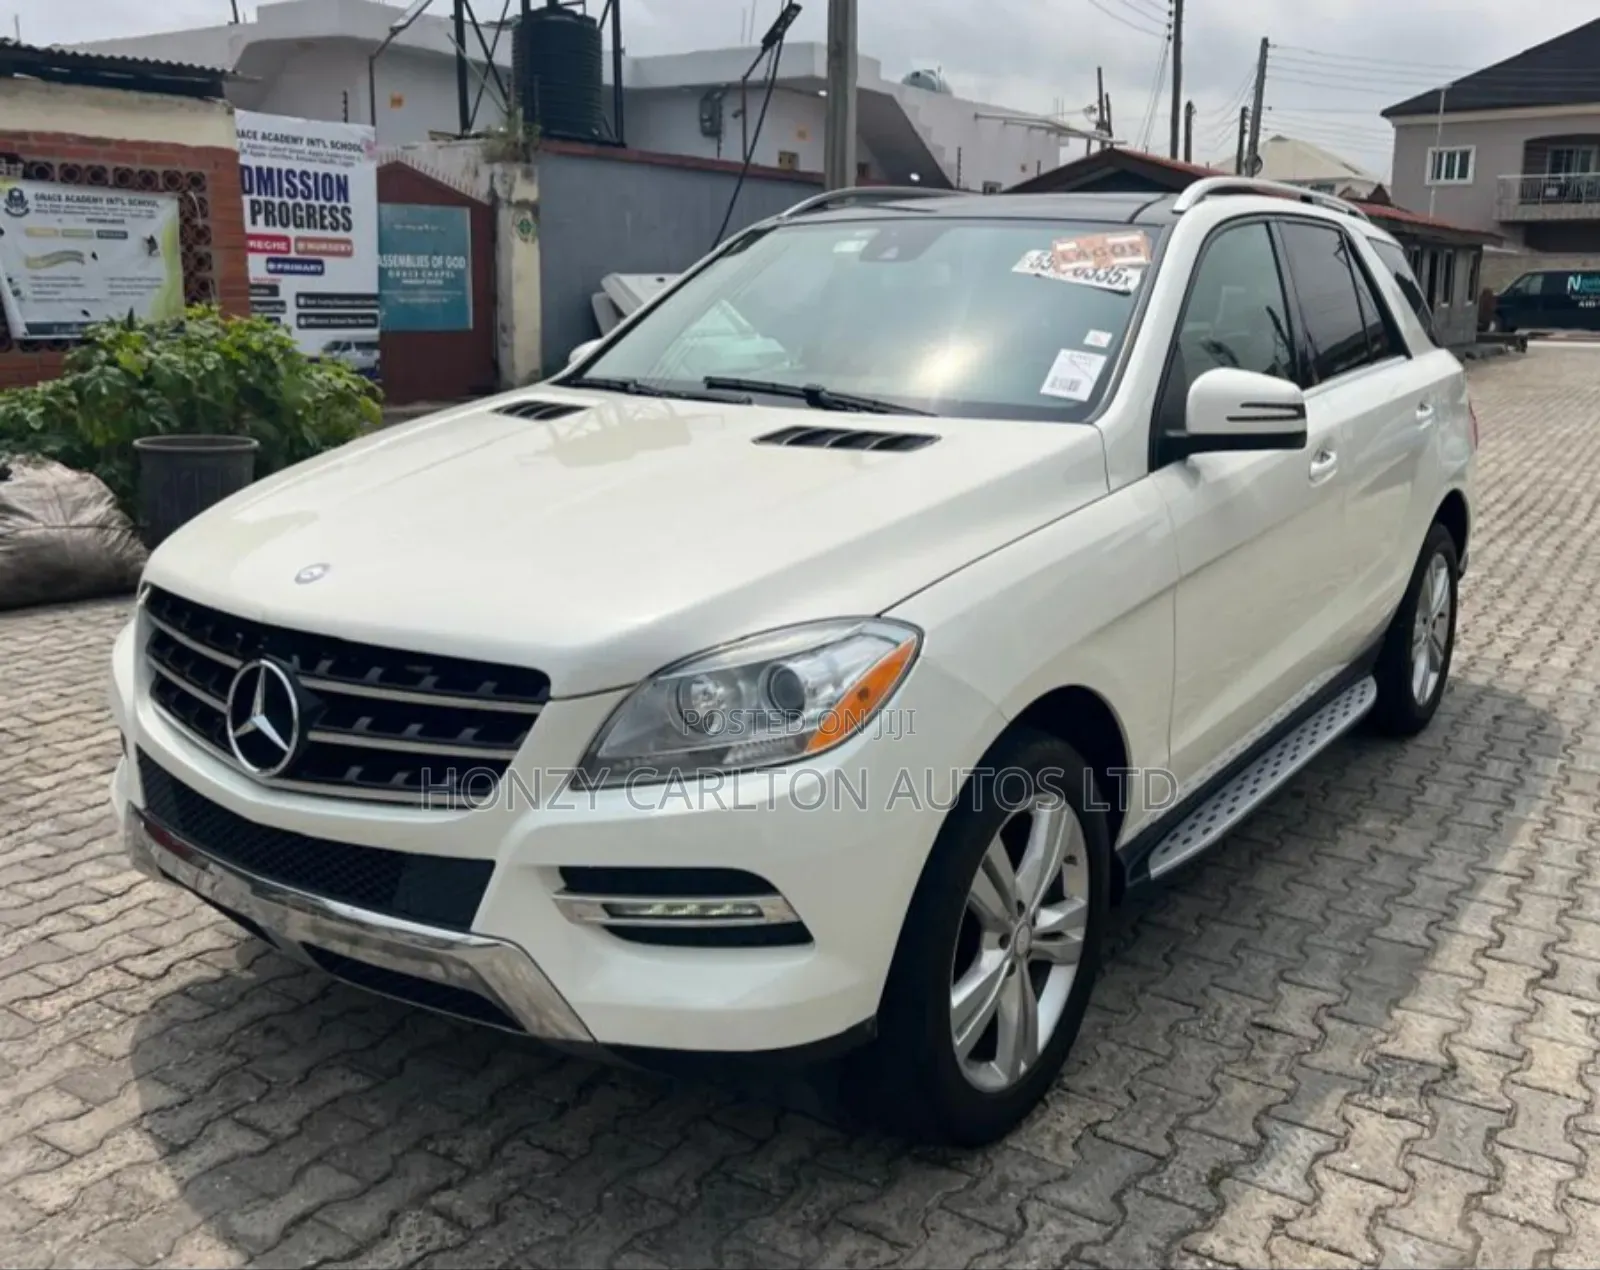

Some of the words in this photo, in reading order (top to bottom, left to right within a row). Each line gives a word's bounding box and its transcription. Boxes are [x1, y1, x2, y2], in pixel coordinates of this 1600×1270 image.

[235, 128, 258, 141] RACE
[261, 131, 304, 145] ACADEMY
[330, 139, 365, 154] SCHOOL
[240, 163, 350, 203] DMISSION
[34, 191, 62, 203] GRACE
[65, 193, 104, 205] ACADEMY
[128, 198, 160, 209] SCHOOL
[249, 199, 353, 232] PROGRESS
[276, 262, 323, 273] PRIMARY
[377, 253, 430, 269] ASSEMBLIES
[431, 254, 444, 269] OF
[445, 255, 467, 269] GOD
